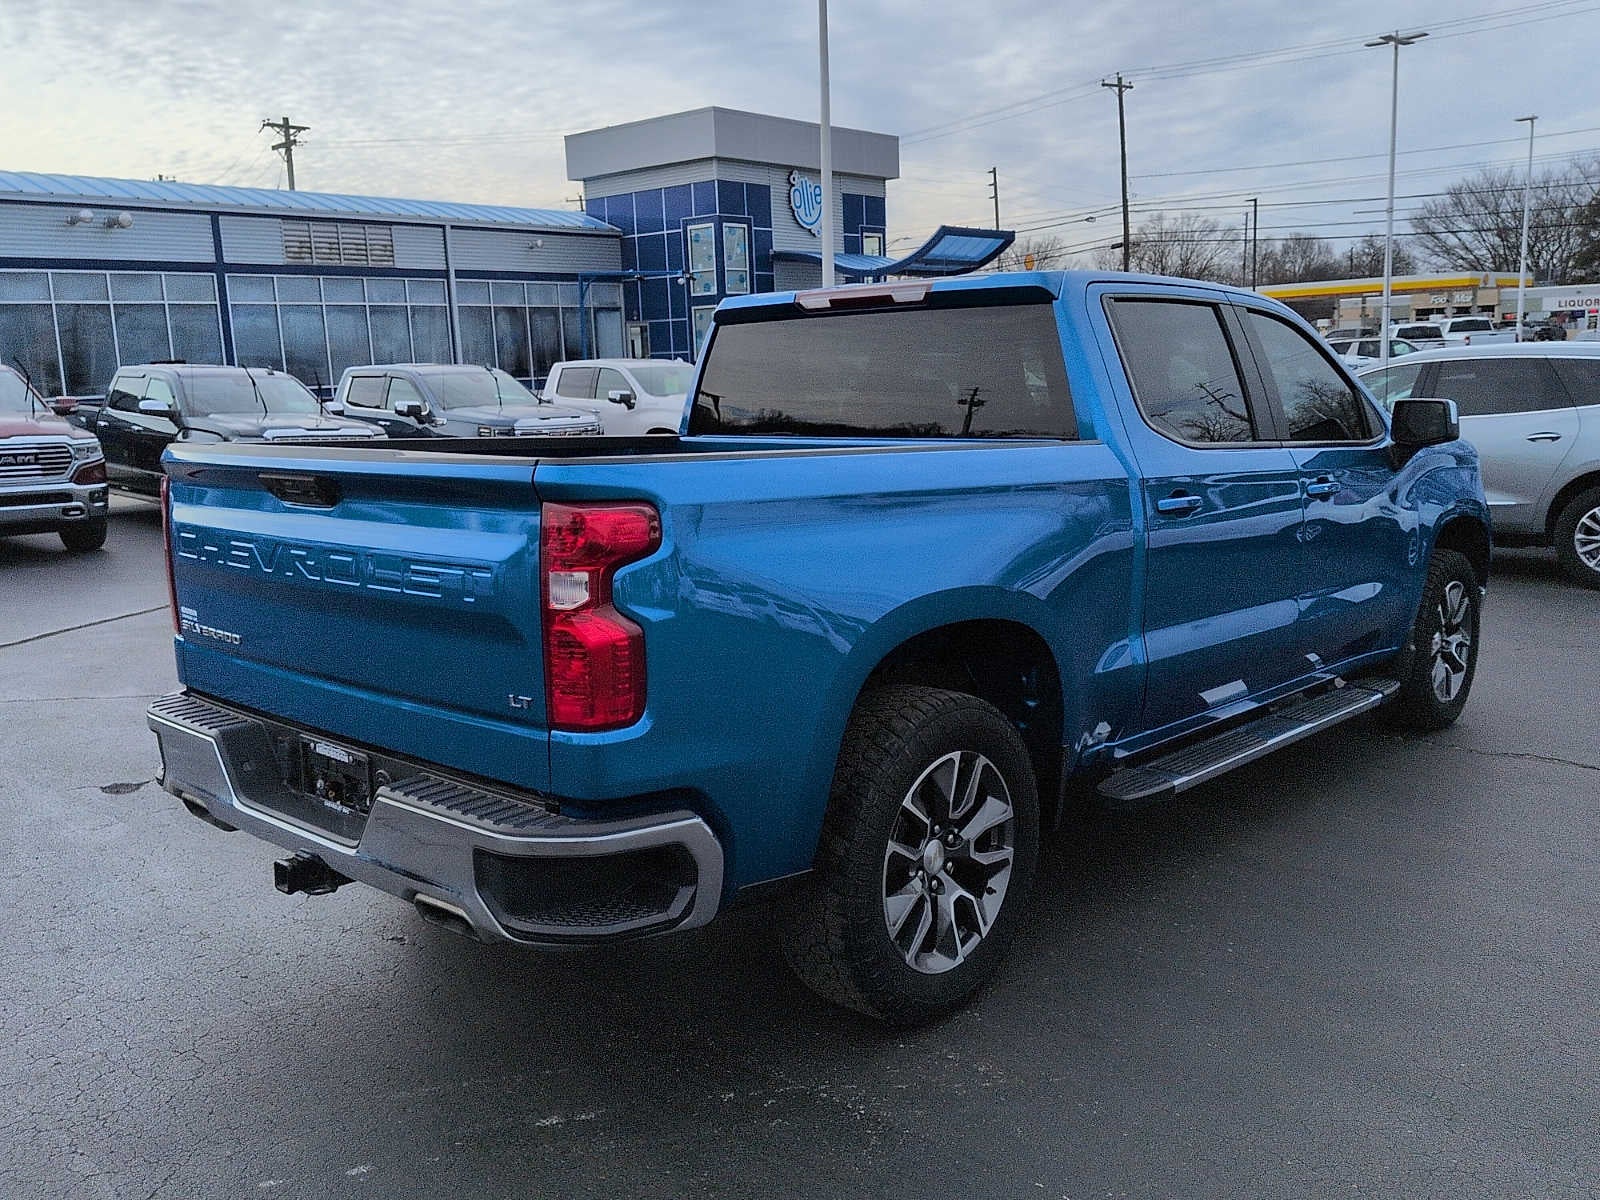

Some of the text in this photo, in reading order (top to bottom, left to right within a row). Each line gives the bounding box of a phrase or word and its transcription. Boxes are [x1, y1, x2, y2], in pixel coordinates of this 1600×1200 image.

[1431, 293, 1474, 304] Foo Mar
[178, 532, 494, 602] CHEVROLET
[181, 619, 241, 645] SILVERADO
[508, 694, 533, 709] LT
